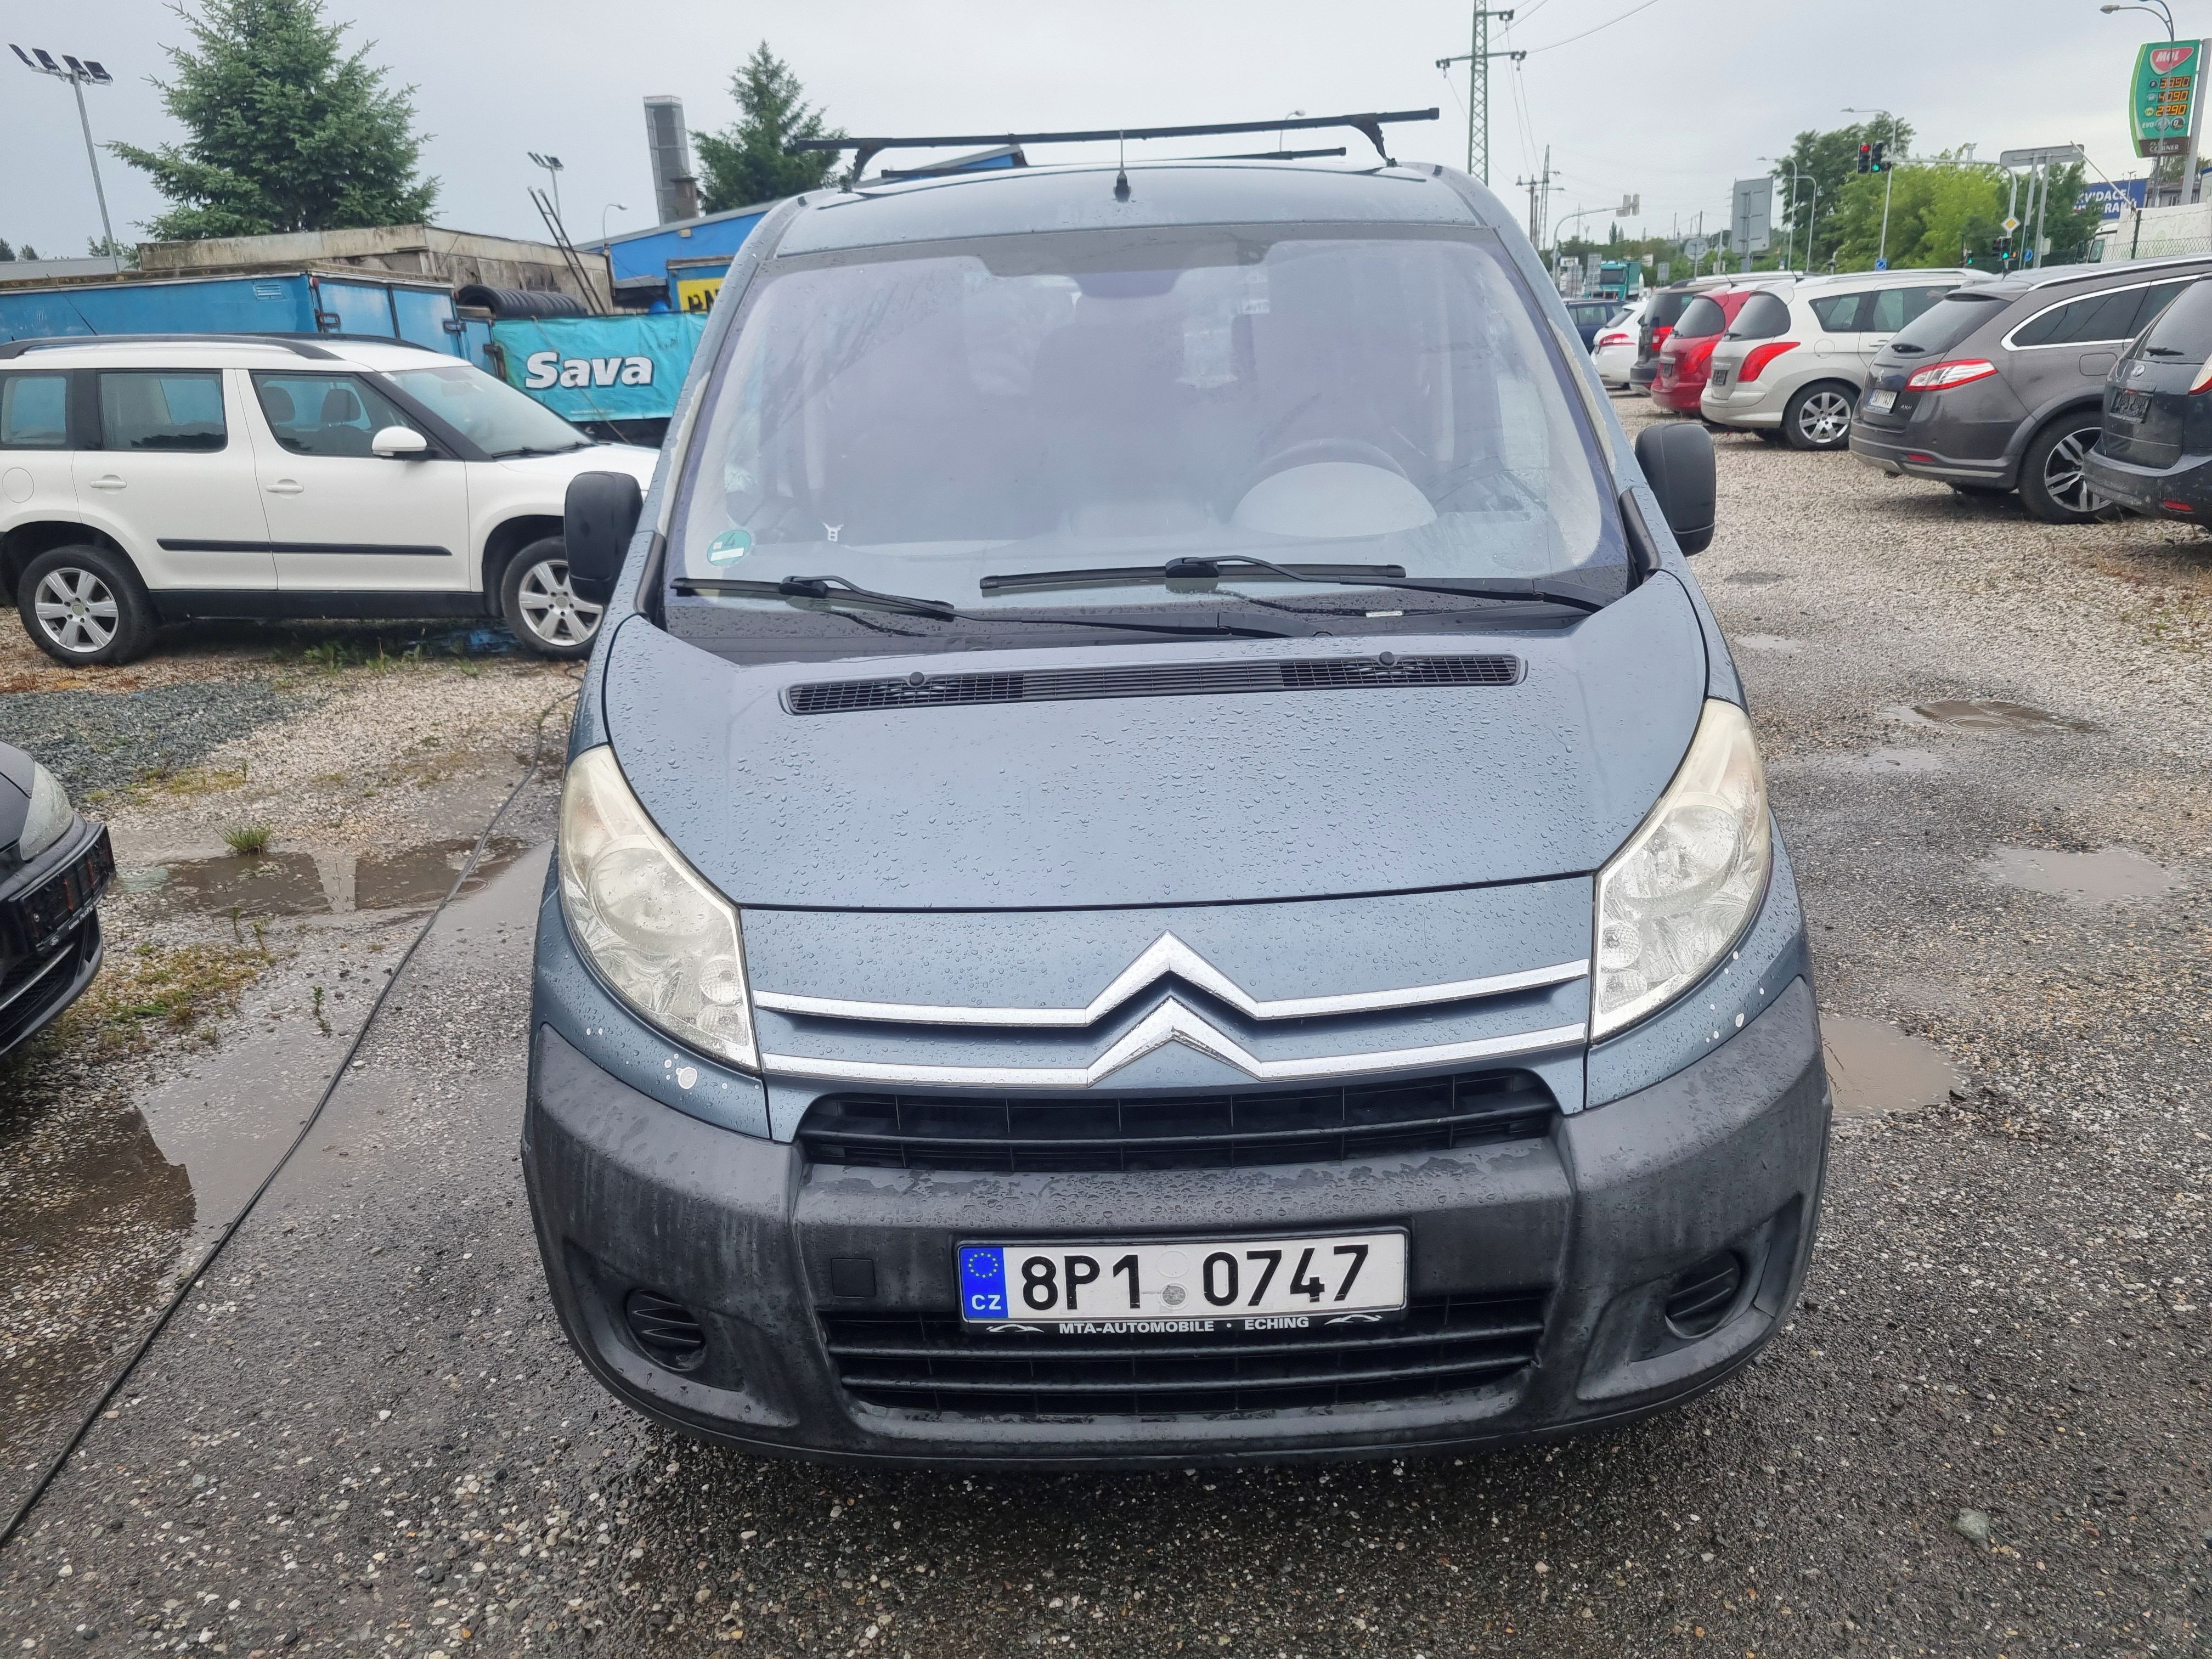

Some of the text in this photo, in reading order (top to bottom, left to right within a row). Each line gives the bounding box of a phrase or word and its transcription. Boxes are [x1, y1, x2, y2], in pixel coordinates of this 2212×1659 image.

[2155, 50, 2180, 62] MOL
[526, 352, 653, 388] Sava
[1022, 1244, 1369, 1311] 8P1 0747
[972, 1294, 1001, 1310] CZ
[1059, 1317, 1310, 1334] MTA-AUTOMOBILE ECHING
